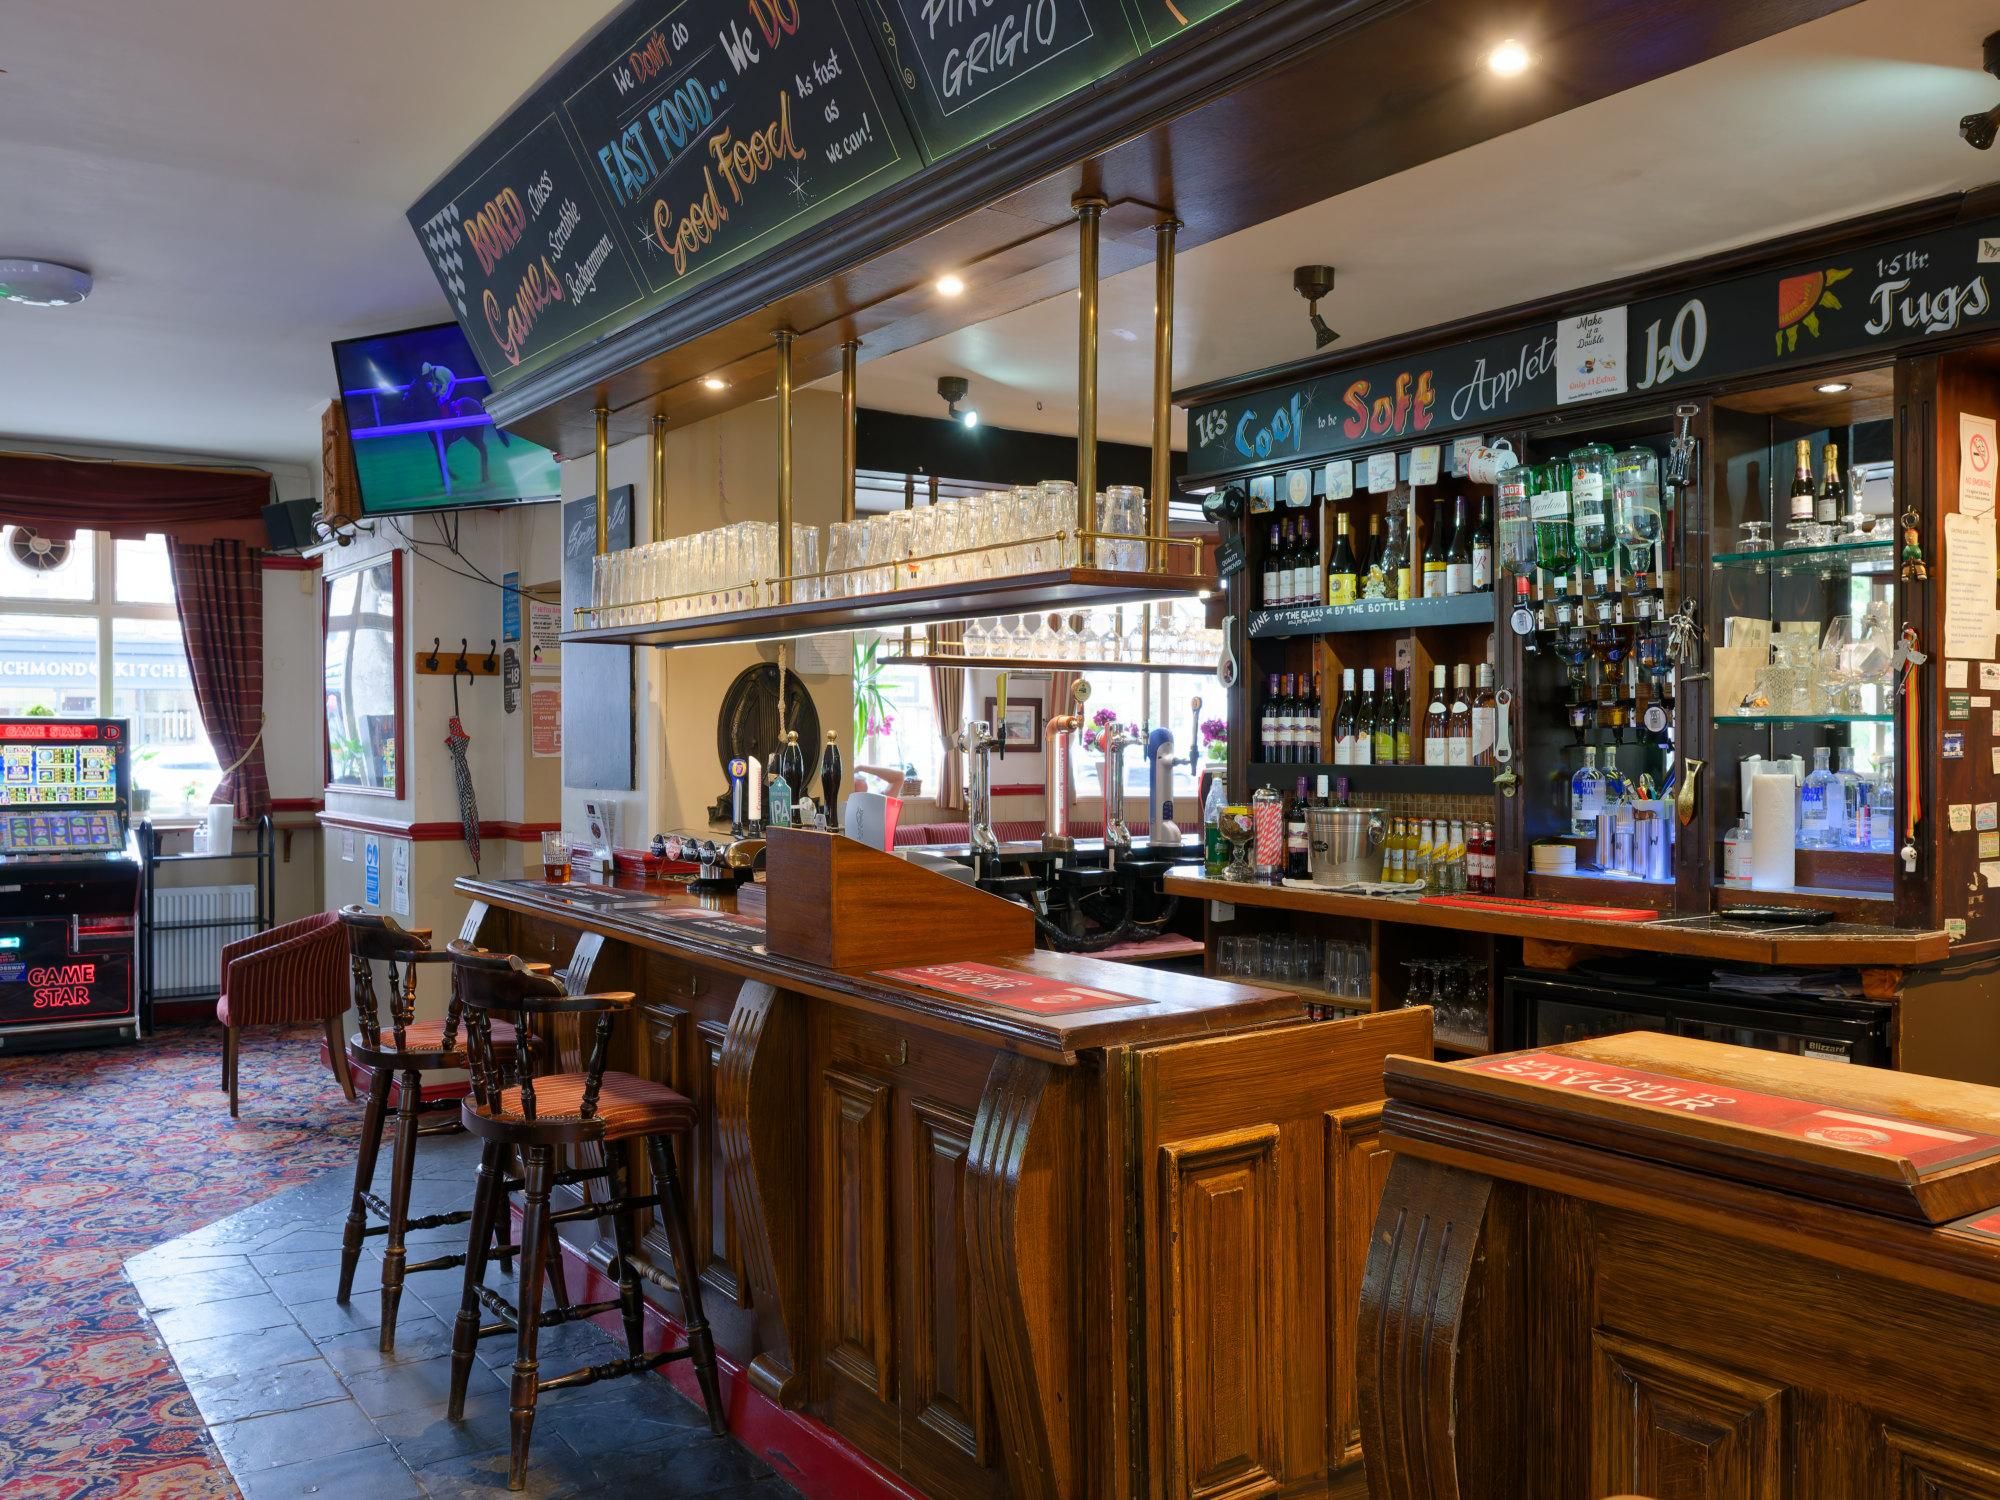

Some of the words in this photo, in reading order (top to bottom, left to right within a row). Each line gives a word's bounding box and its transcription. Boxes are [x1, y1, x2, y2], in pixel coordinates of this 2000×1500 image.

[613, 66, 634, 95] We
[671, 22, 689, 51] do
[719, 20, 759, 75] We
[749, 0, 801, 49] DO
[942, 0, 1057, 98] GRIGIO
[795, 74, 814, 100] As
[814, 48, 842, 86] fast
[824, 98, 840, 124] as
[825, 137, 845, 164] we
[843, 112, 874, 155] can!
[598, 125, 659, 206] FAST
[652, 166, 730, 276] Good
[709, 90, 807, 204] Food
[463, 187, 527, 278] BORED
[549, 200, 582, 256] Scrabble
[571, 233, 614, 304] Backgammon
[482, 256, 565, 367] Games
[1577, 314, 1602, 329] Make
[1864, 275, 1990, 336] Jugs
[1577, 335, 1604, 349] Double
[1636, 298, 1708, 390] J2O
[1196, 408, 1228, 448] It's
[1234, 391, 1304, 460] Cool
[1318, 416, 1326, 429] to
[1327, 413, 1337, 428] be
[1343, 370, 1436, 440] Soft
[1248, 611, 1270, 636] WINE
[1274, 613, 1283, 621] BY
[1285, 611, 1300, 620] THE
[1301, 608, 1324, 619] GLASS
[1335, 605, 1345, 615] BY
[1347, 602, 1364, 614] THE
[1368, 600, 1406, 613] BOTTLE
[115, 662, 188, 679] KITCHE
[5, 726, 45, 737] GAME
[50, 724, 82, 737] STAR
[770, 799, 791, 825] IPA
[28, 964, 95, 987] GAME
[33, 986, 91, 1008] STAR
[1809, 1042, 1846, 1053] Blizzard
[1487, 1063, 1716, 1112] SAVOUR
[1518, 1059, 1602, 1078] MAKE
[1606, 1076, 1687, 1095] TIME
[1697, 1092, 1737, 1104] TO
